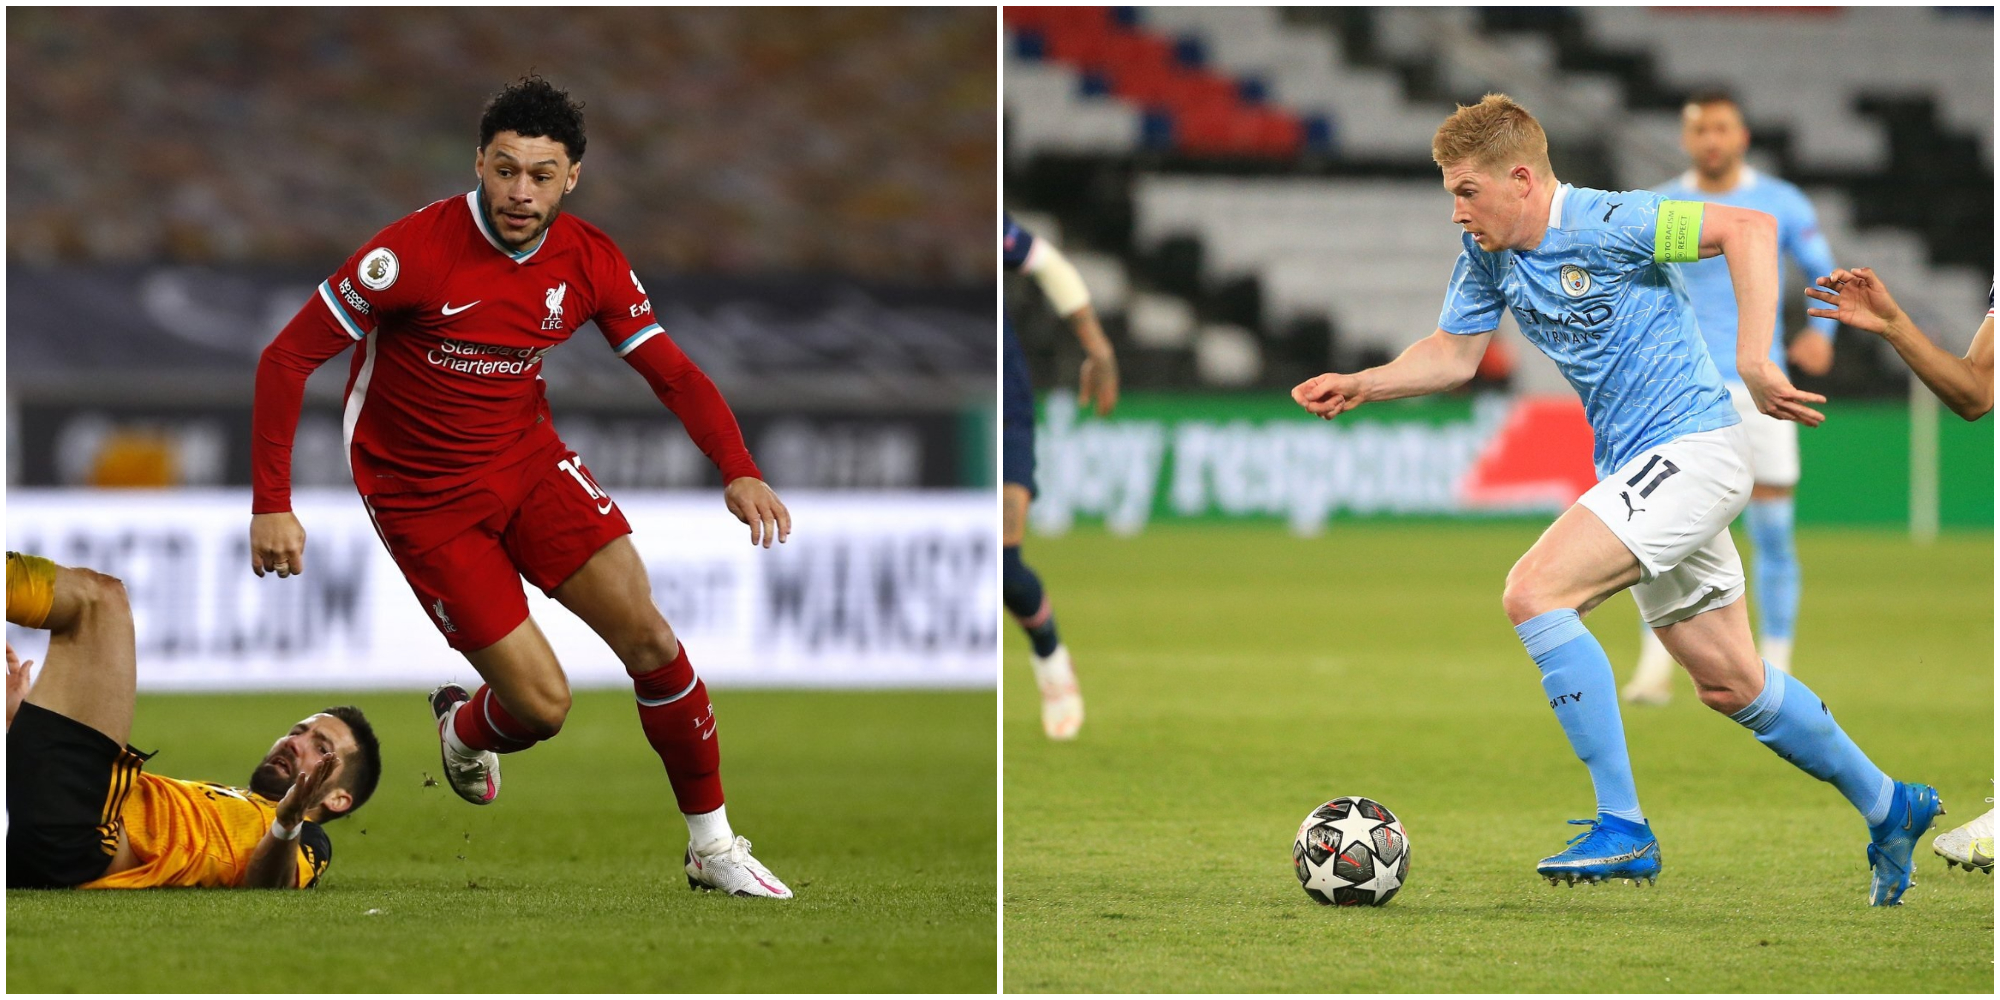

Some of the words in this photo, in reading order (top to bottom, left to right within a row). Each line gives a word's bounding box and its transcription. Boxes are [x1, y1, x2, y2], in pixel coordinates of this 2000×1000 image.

[1665, 210, 1675, 240] RACISM
[1677, 215, 1688, 250] RESPECT
[339, 277, 352, 291] No
[349, 289, 370, 309] room
[344, 293, 370, 315] racism
[441, 338, 534, 359] Standard
[1543, 330, 1602, 345] IRWAYS
[427, 349, 524, 375] Chartered
[1626, 454, 1681, 500] 17
